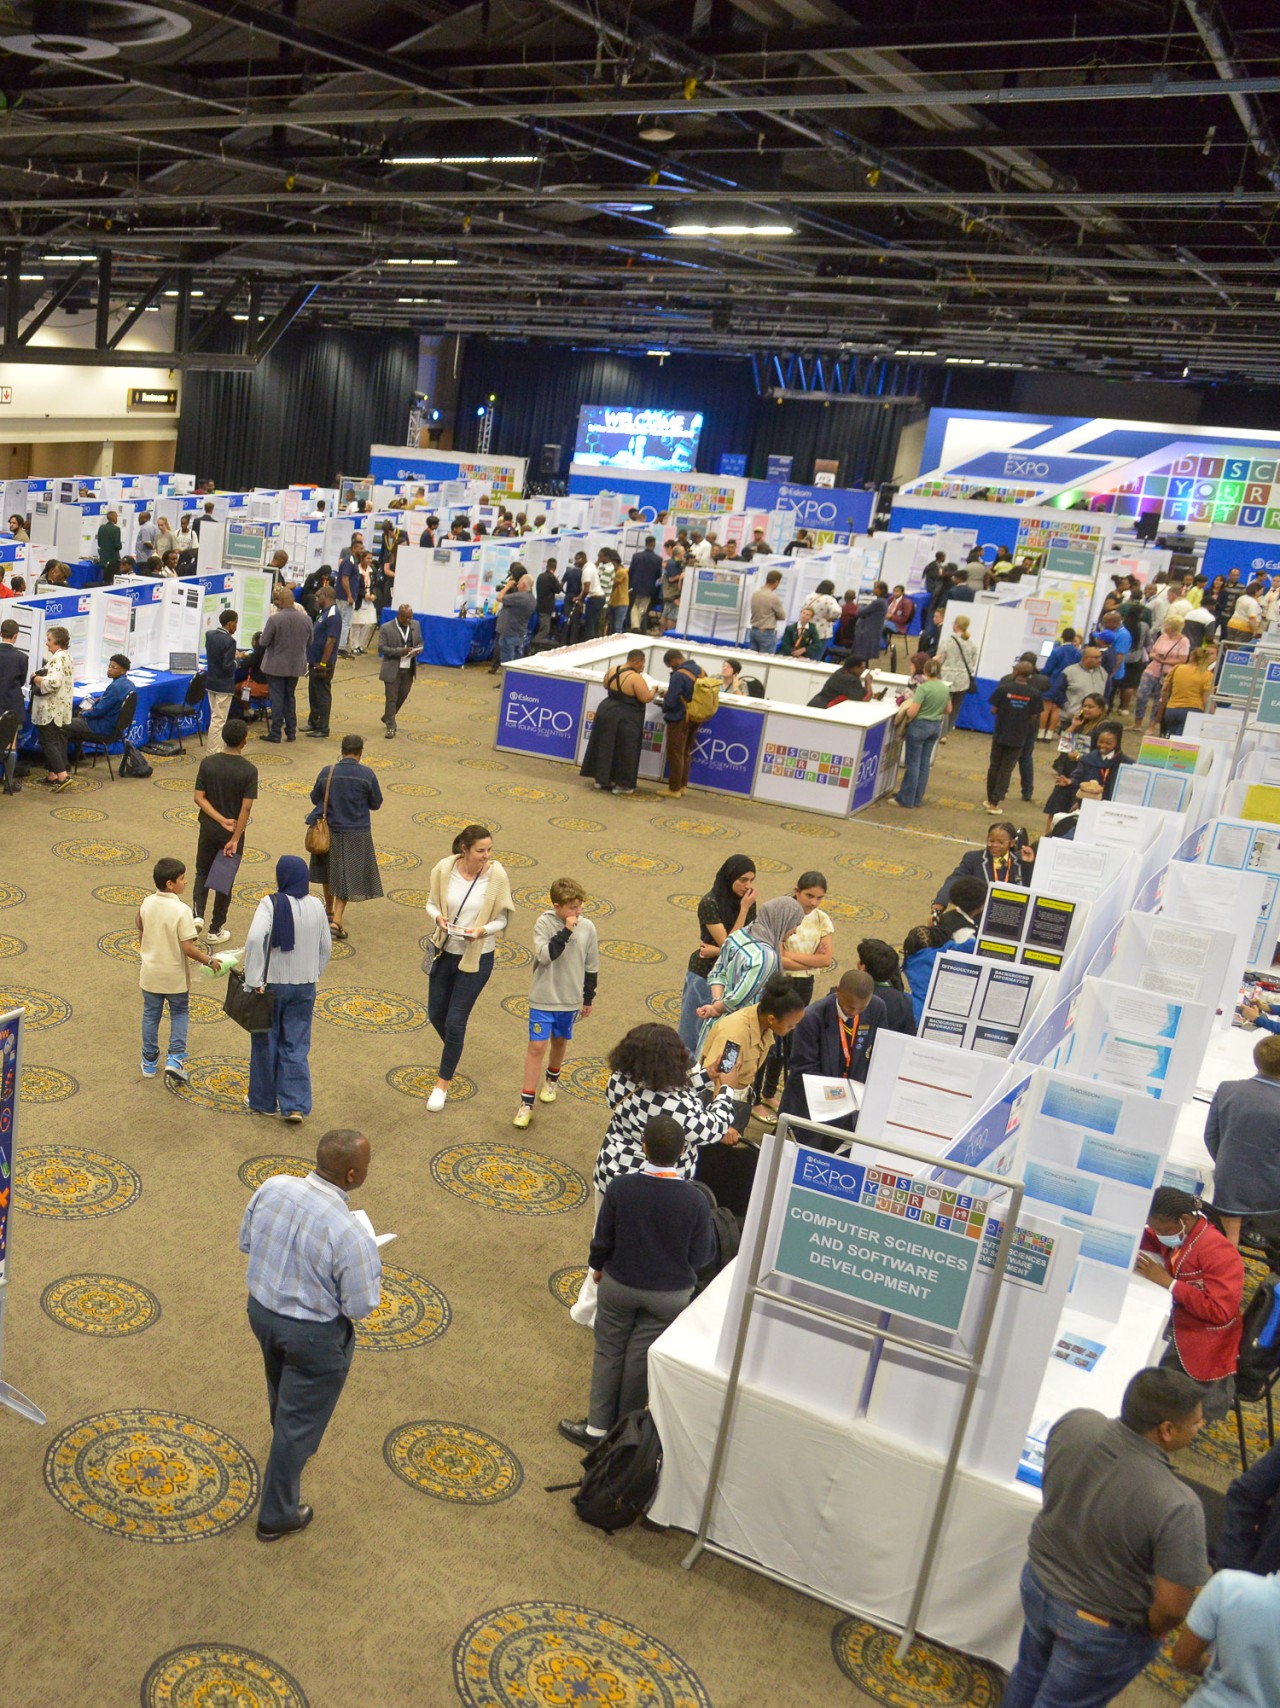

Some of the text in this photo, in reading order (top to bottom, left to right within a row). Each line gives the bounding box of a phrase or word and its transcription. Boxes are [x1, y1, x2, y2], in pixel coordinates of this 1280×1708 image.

[1003, 460, 1049, 477] EXPO
[789, 488, 812, 497] Eskom
[776, 497, 837, 521] EXPO
[1022, 519, 1101, 533] DISCOVER
[45, 603, 63, 614] EXPO
[518, 693, 540, 704] Eskom
[506, 702, 573, 732] EXPO
[518, 724, 537, 733] YOUNG
[537, 728, 571, 739] SCIENTISTS
[689, 738, 749, 765] XPO
[767, 744, 852, 766] DISCOVER
[766, 755, 804, 768] YOUR
[763, 765, 824, 783] FUTURE
[941, 963, 979, 976] INTRODUCTION
[994, 970, 1030, 981] BACKGROUND
[993, 974, 1029, 985] INFORMATION
[927, 1022, 963, 1033] INFORMATION
[928, 1018, 963, 1028] BACKGROUND
[984, 1032, 1009, 1042] PROBLEM
[813, 1158, 830, 1167] Eskom
[803, 1162, 856, 1189] EXPO
[869, 1170, 984, 1211] DISCOVER
[869, 1184, 920, 1207] YOUR
[865, 1195, 947, 1228] FUTURE
[790, 1206, 880, 1244] COMPUTER
[883, 1235, 968, 1272] SCIENCES
[809, 1232, 940, 1284] AND SOFTWARE
[809, 1251, 931, 1300] DEVELOPMENT
